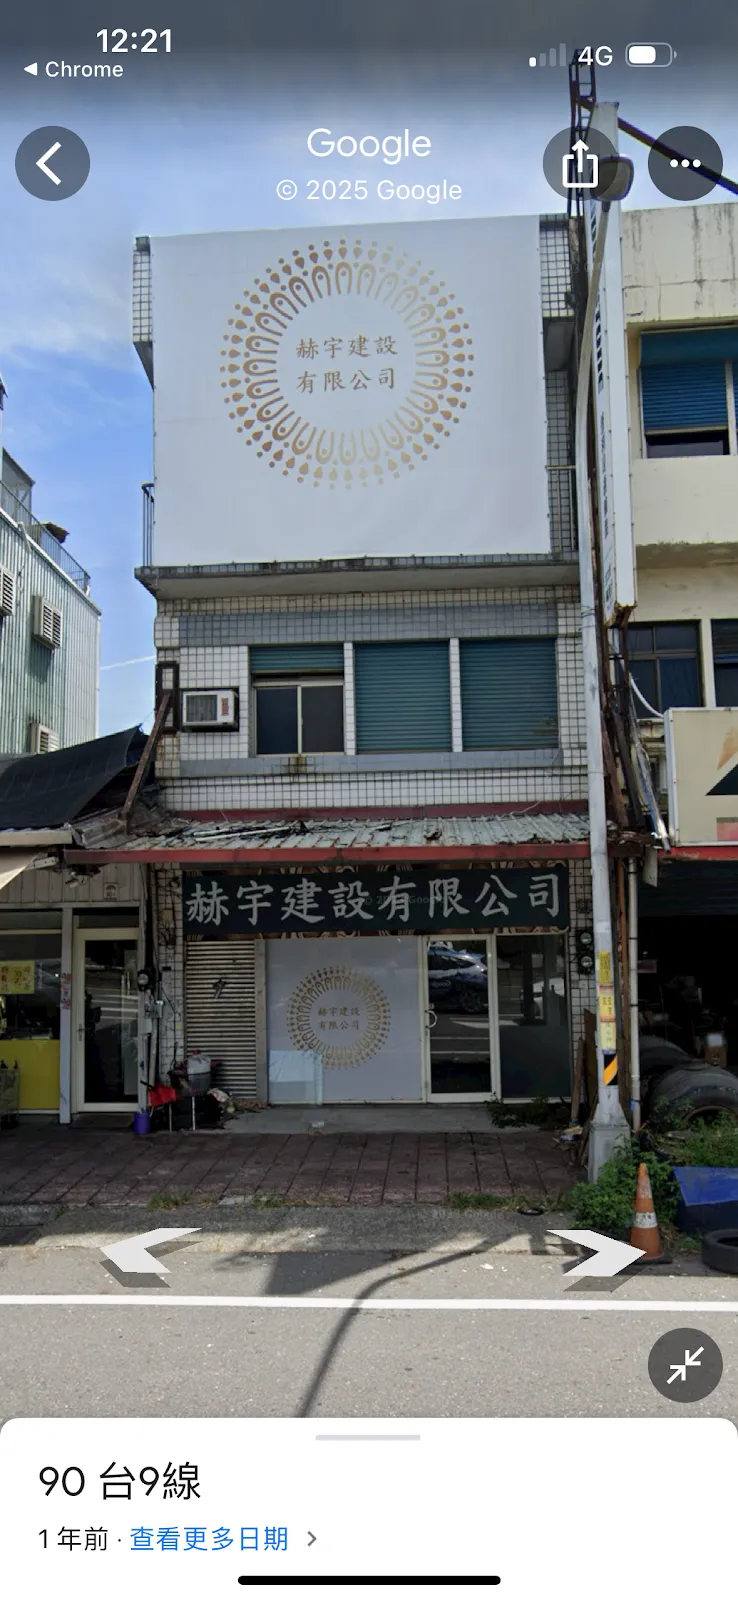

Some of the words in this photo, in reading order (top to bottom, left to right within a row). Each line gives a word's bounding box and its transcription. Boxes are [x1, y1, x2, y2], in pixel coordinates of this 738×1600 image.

[296, 335, 398, 360] 赫宇建設
[296, 368, 395, 394] 有限公司
[185, 873, 561, 926] 赫宇建設有限公司
